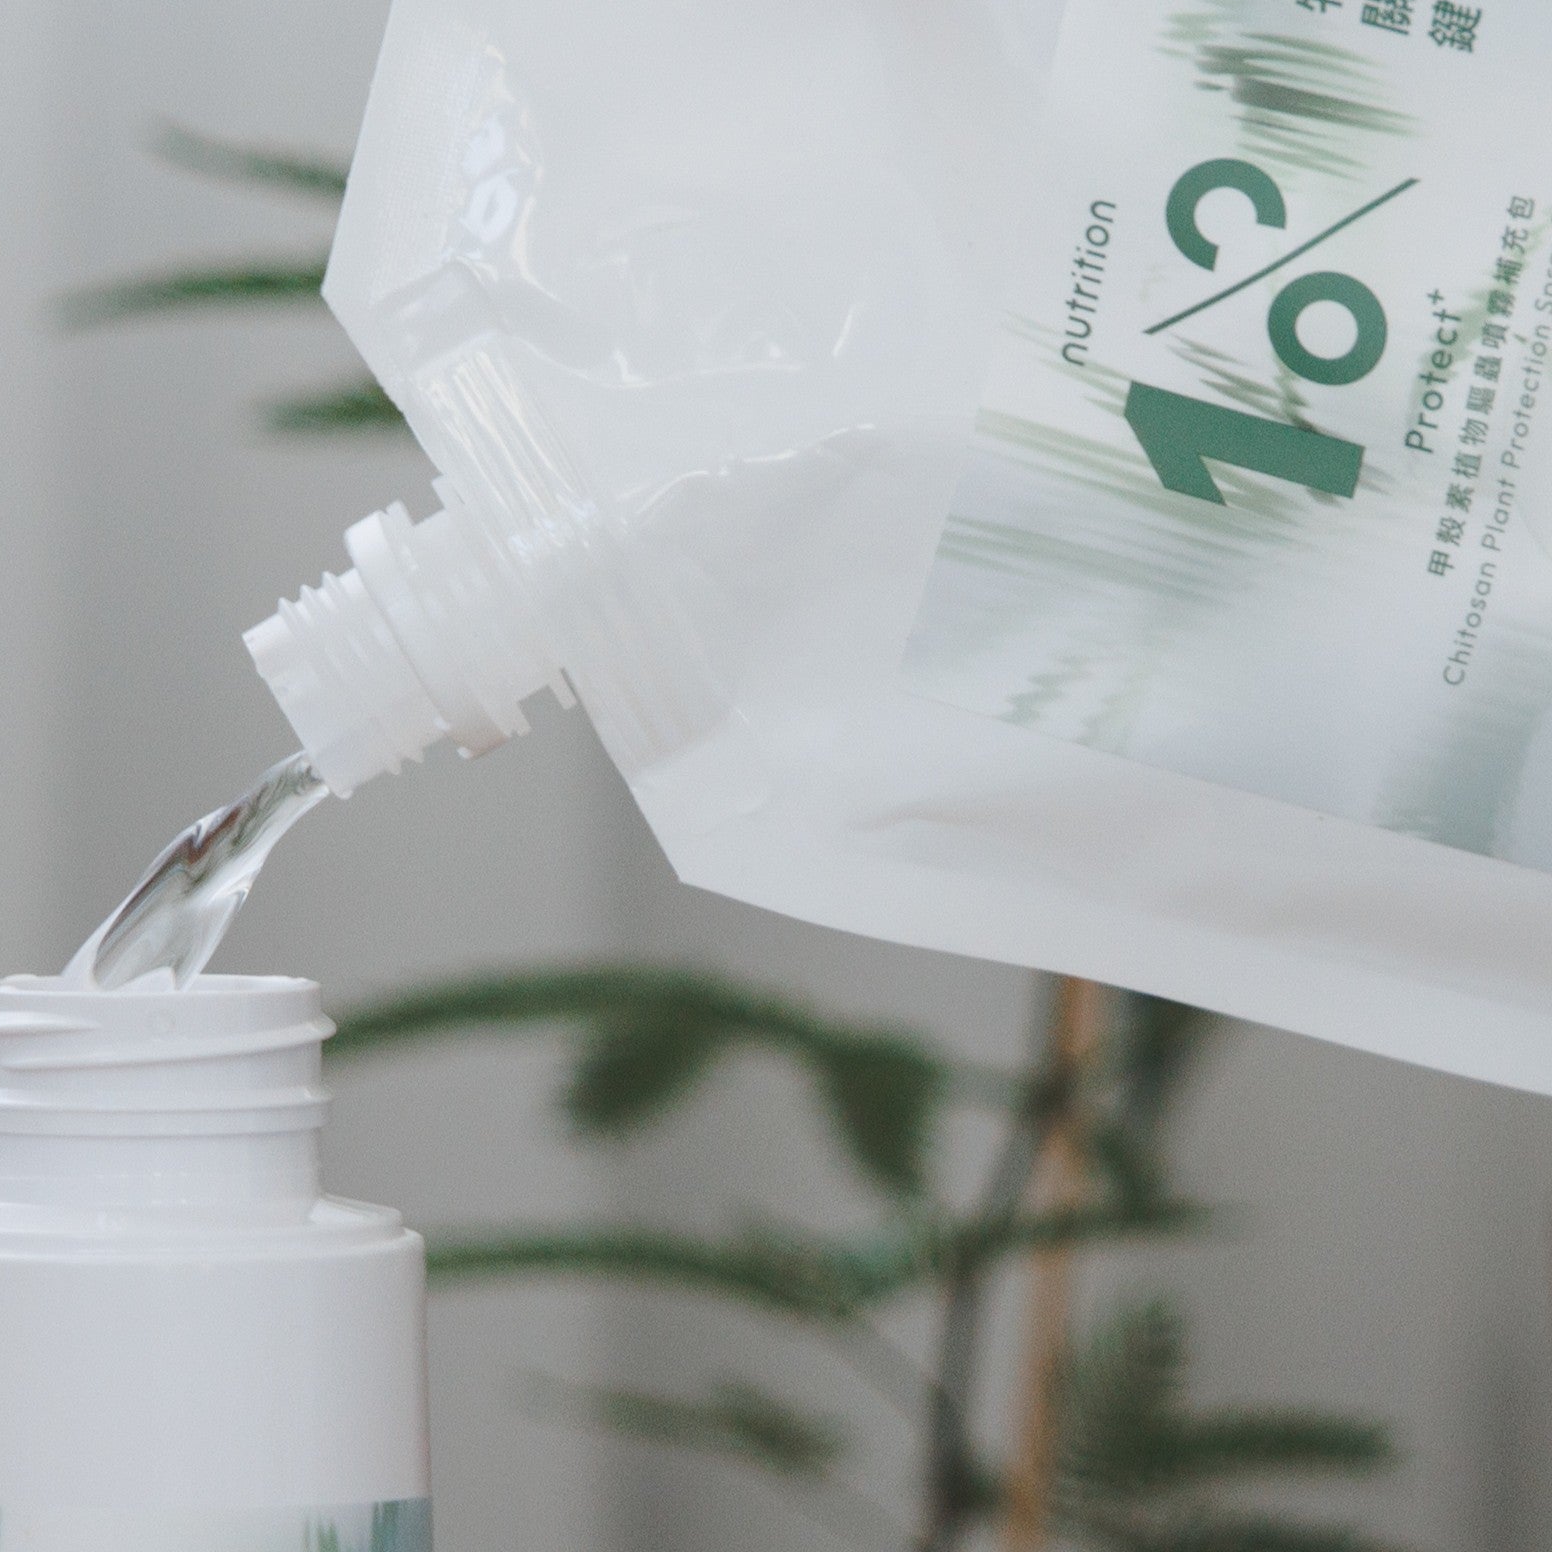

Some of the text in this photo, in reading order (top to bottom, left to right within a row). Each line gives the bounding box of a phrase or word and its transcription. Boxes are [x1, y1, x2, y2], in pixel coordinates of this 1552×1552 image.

[1059, 197, 1117, 366] nutrition
[1426, 192, 1537, 579] 甲殼素植物驅蟲噴霧補充包
[1441, 560, 1497, 688] Chitosan
[1479, 477, 1515, 552] Plant
[1499, 322, 1552, 470] Protection
